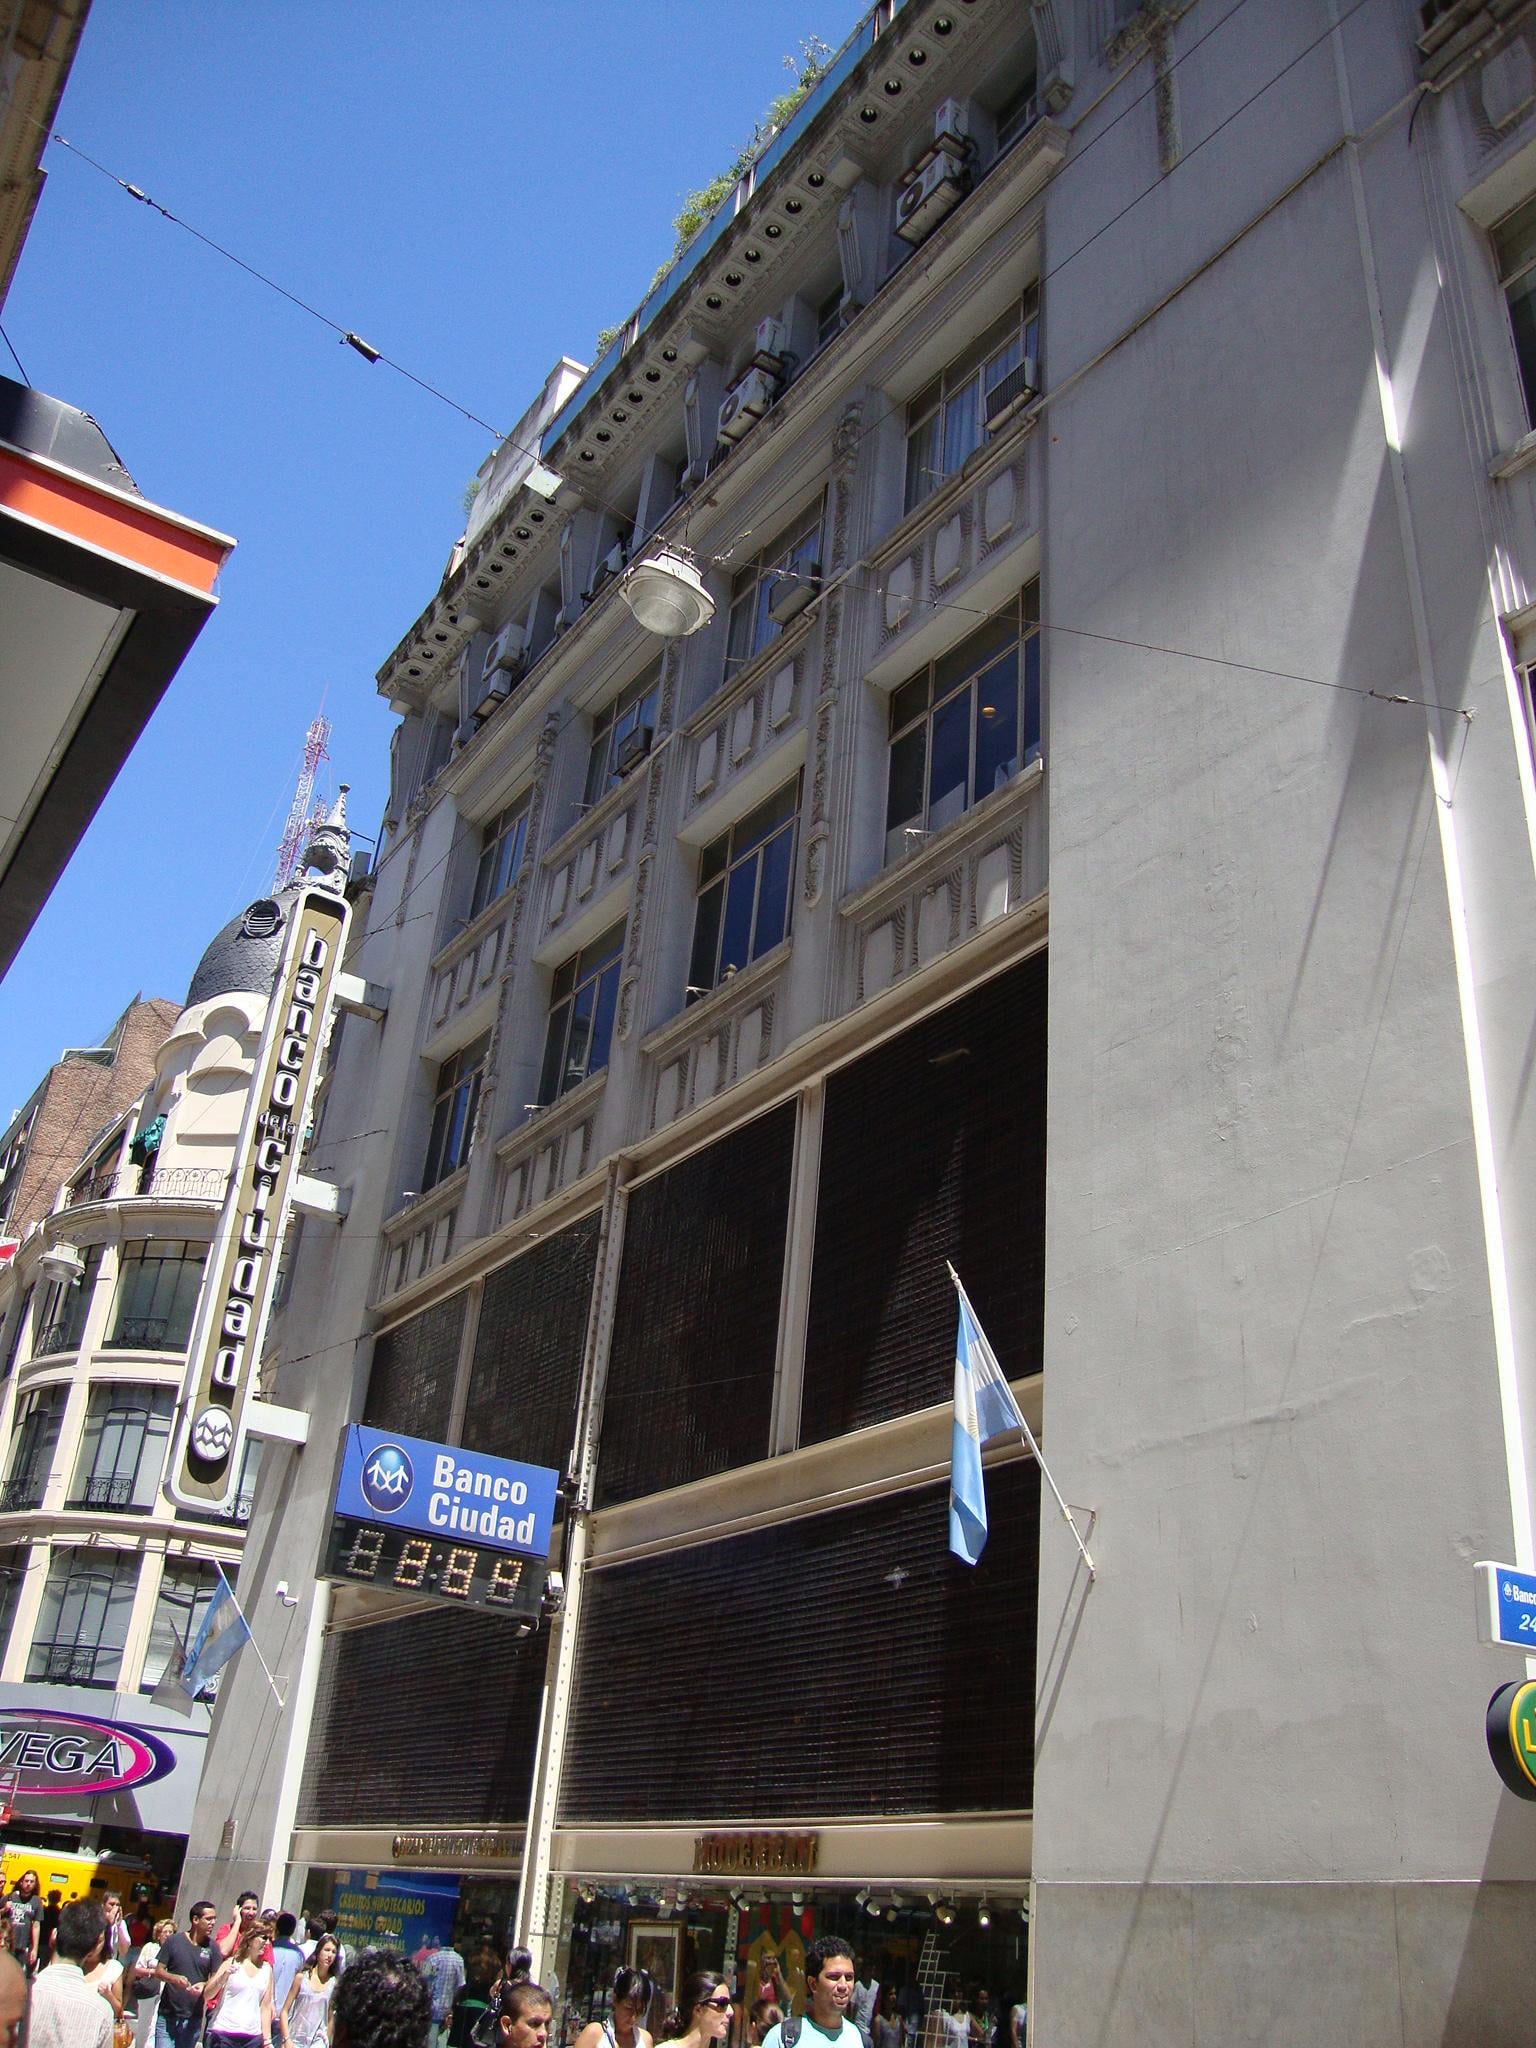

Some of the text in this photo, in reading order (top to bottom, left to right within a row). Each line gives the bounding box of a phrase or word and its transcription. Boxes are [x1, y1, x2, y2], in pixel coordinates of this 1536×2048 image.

[270, 928, 329, 1108] banco
[432, 1454, 528, 1506] Banco
[428, 1492, 536, 1546] Ciudad
